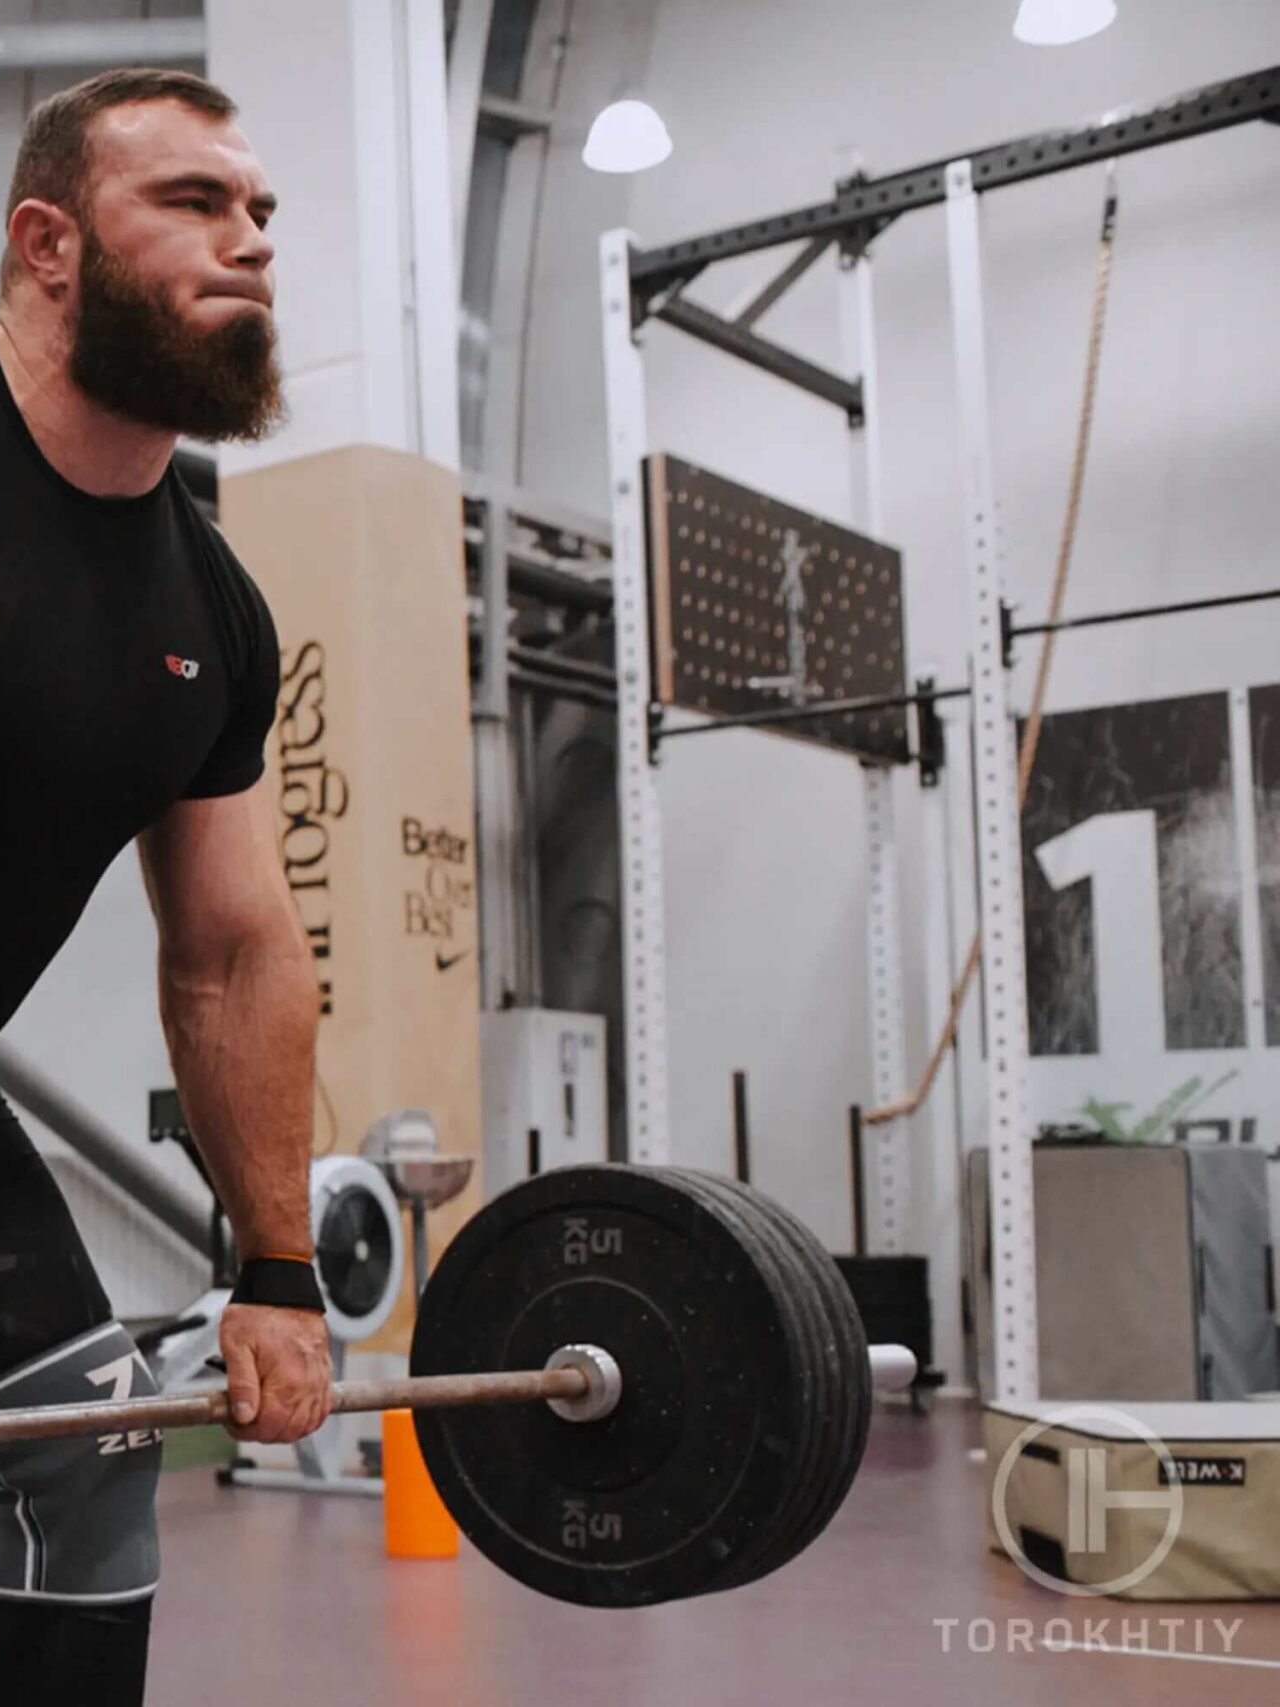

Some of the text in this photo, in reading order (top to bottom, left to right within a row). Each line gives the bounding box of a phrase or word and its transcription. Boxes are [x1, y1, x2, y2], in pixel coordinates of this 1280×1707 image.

[278, 640, 349, 958] rogress
[564, 1218, 588, 1264] KG
[590, 1228, 623, 1256] 5
[562, 1500, 586, 1549] KG
[589, 1513, 621, 1541] 5
